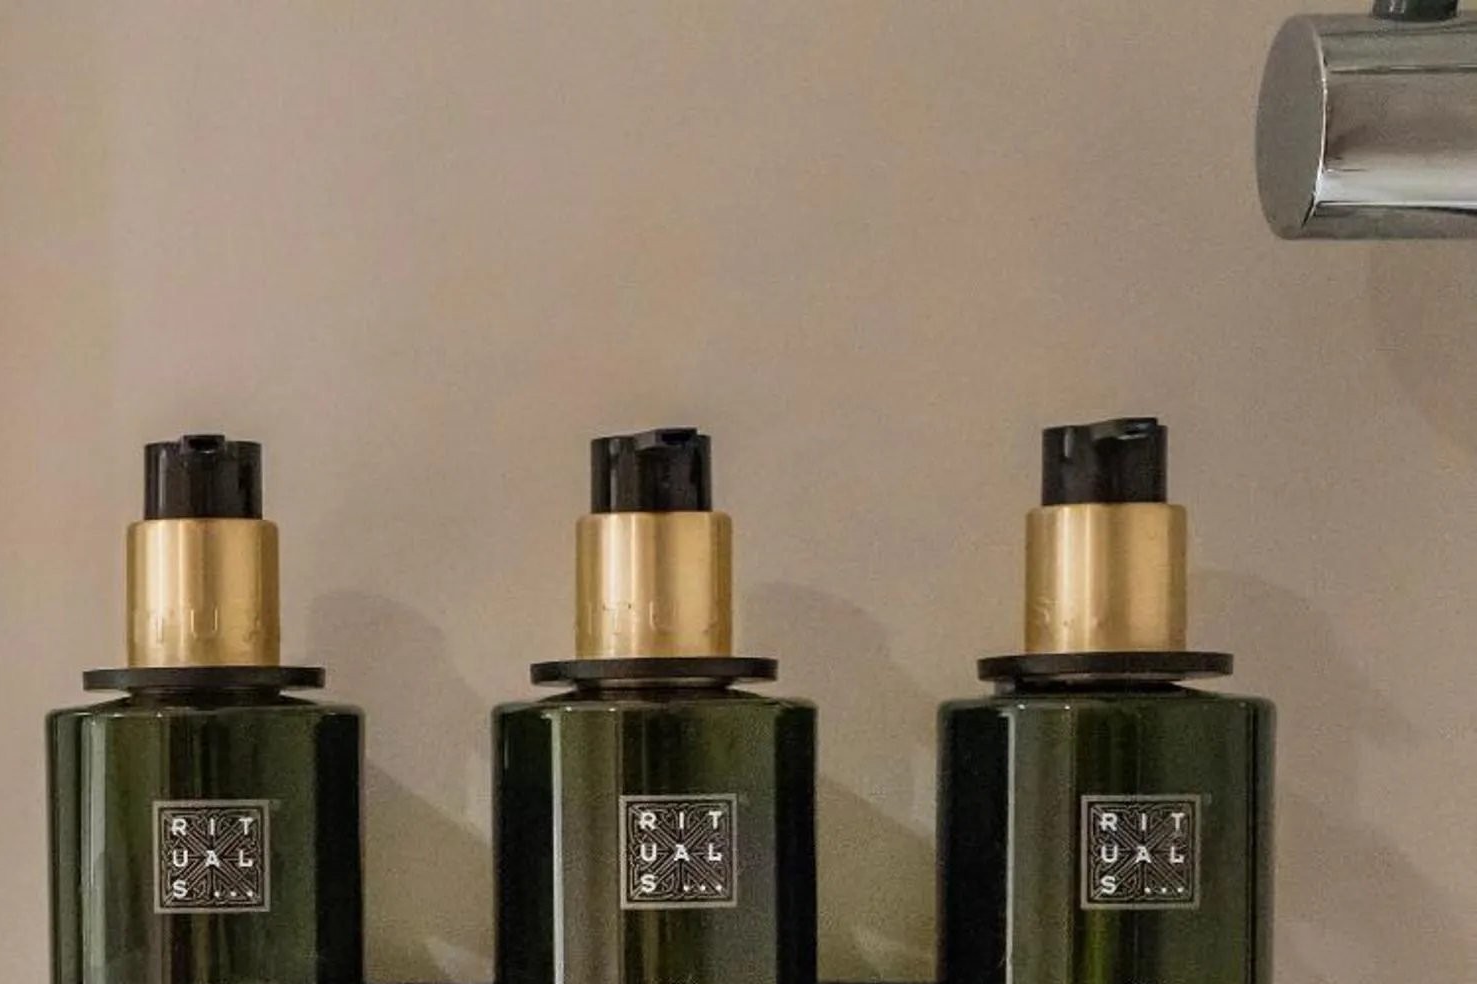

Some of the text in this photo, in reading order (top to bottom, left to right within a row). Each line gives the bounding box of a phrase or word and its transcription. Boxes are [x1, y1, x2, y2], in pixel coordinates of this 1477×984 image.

[172, 818, 253, 836] RIT
[640, 811, 723, 830] RIT
[1100, 812, 1185, 831] RIT
[173, 850, 253, 868] UAL
[640, 843, 723, 861] UAL
[1101, 845, 1184, 863] UAL
